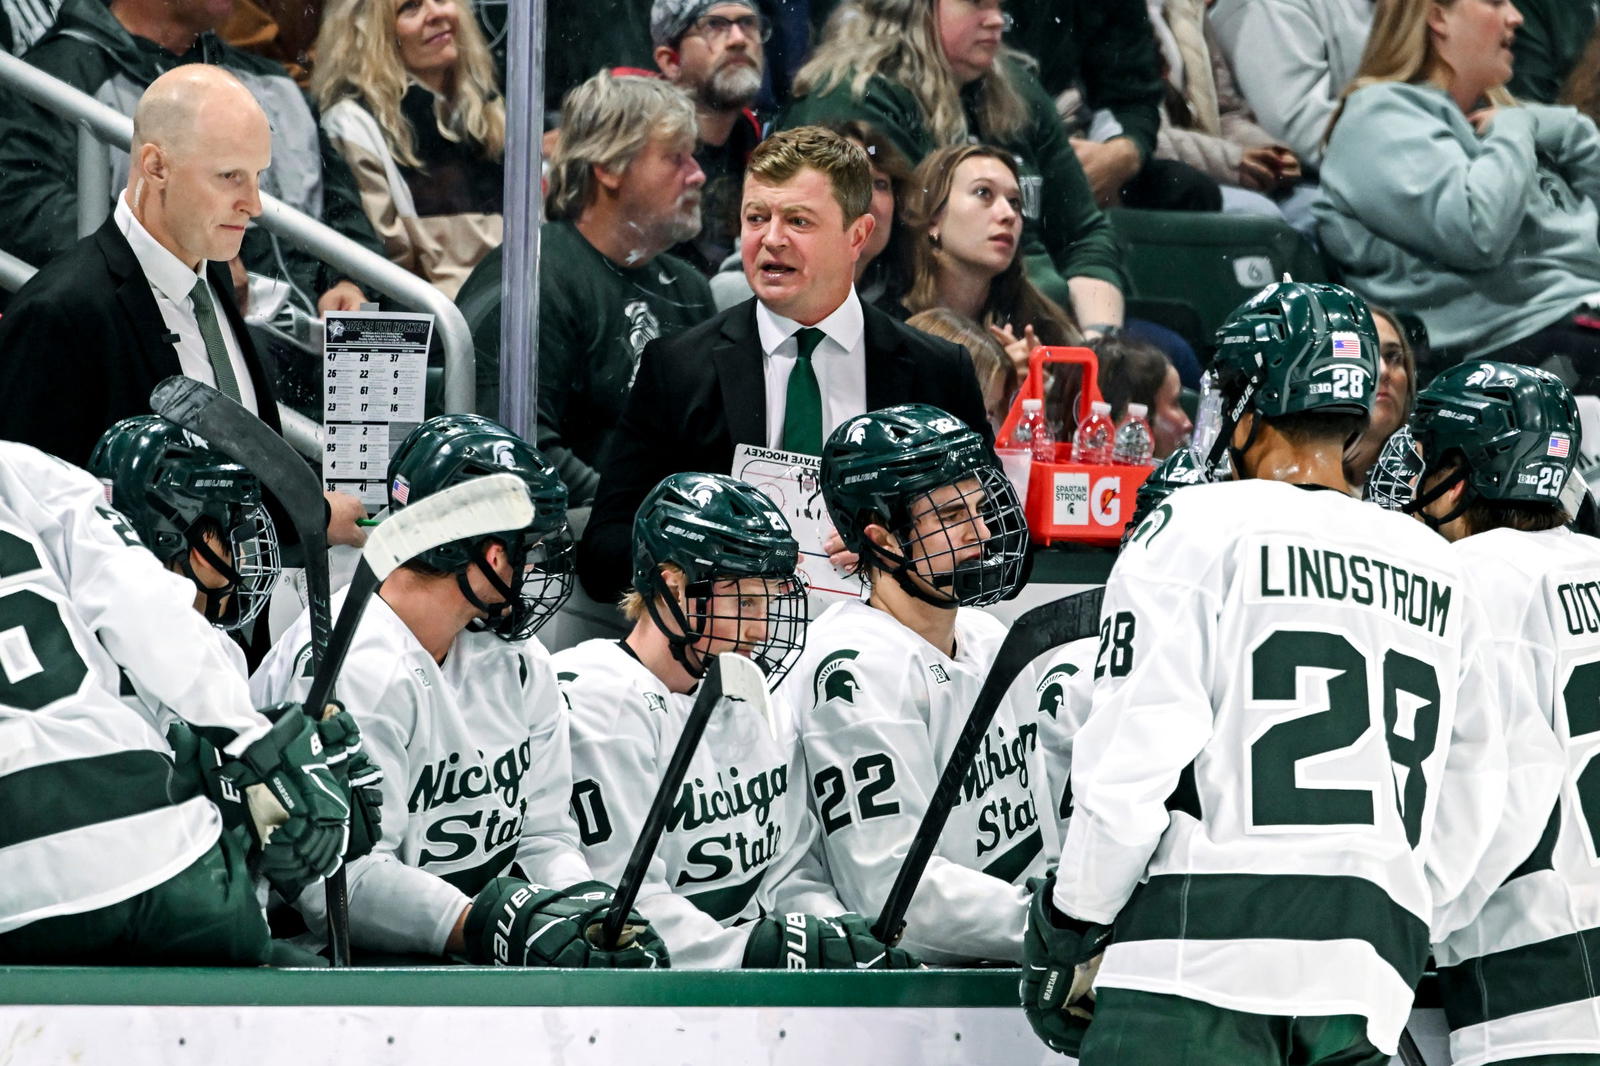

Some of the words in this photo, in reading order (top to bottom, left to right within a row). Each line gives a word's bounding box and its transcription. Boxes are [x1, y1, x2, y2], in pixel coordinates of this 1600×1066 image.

[393, 322, 430, 333] HOCKEY
[327, 353, 337, 361] 47
[360, 354, 369, 362] 29
[390, 354, 399, 362] 37
[327, 369, 337, 378] 26
[360, 370, 369, 378] 22
[393, 370, 399, 379] 6
[1332, 368, 1364, 399] 28
[328, 386, 336, 394] 91
[360, 386, 369, 395] 61
[393, 386, 398, 395] 9
[328, 403, 336, 411] 23
[361, 403, 368, 412] 17
[390, 404, 398, 412] 16
[328, 426, 336, 435] 19
[362, 427, 368, 435] 2
[326, 443, 336, 452] 95
[360, 444, 367, 452] 15
[743, 447, 789, 462] HOCKEY
[330, 461, 336, 469] 4
[360, 461, 367, 470] 13
[844, 471, 879, 485] BAUER
[1536, 466, 1564, 498] 29
[194, 479, 234, 488] BAUER
[327, 483, 336, 492] 36
[359, 483, 367, 492] 41
[1056, 485, 1087, 493] SPARTAN
[1056, 493, 1087, 502] STRONG
[1090, 476, 1121, 527] G
[664, 524, 706, 543] BAUER
[1261, 544, 1452, 637] LINDSTROM
[1093, 611, 1136, 682] 28
[1251, 629, 1441, 851] 28
[813, 753, 900, 837] 22
